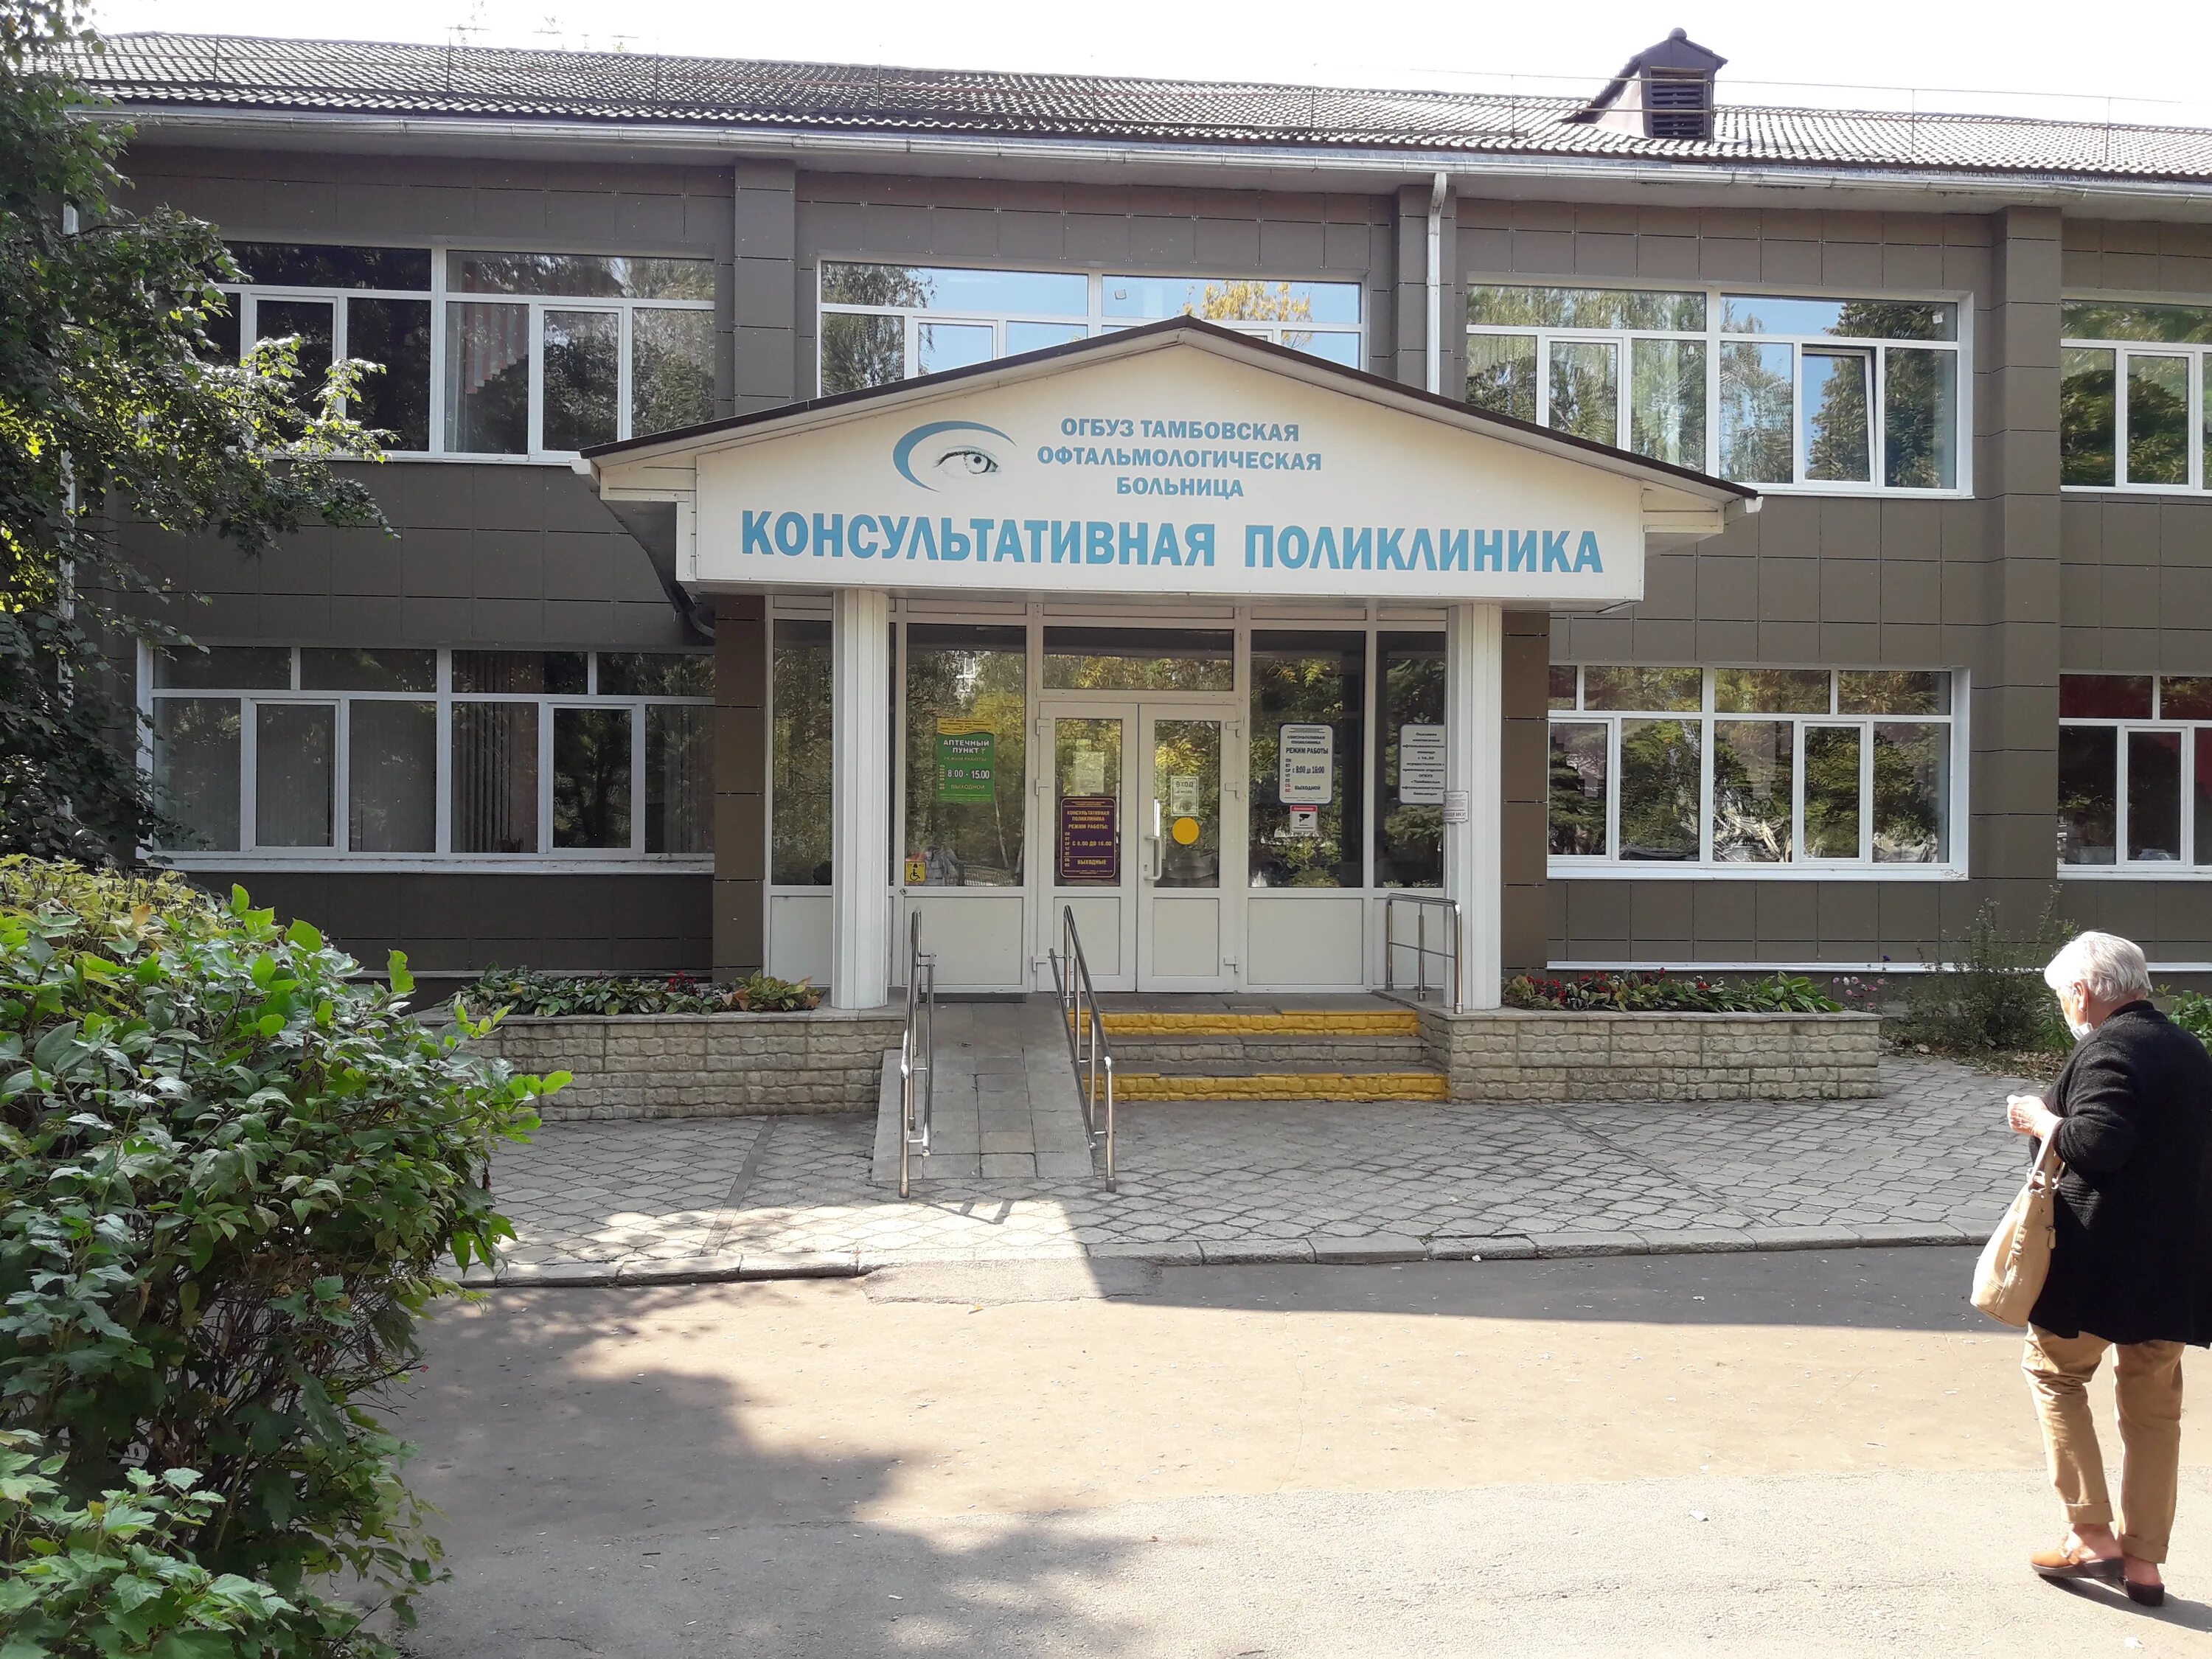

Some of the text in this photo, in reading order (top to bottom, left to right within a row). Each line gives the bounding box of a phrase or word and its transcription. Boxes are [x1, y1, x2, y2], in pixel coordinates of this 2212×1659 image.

[1061, 419, 1298, 440] ОГБУЗ ТАМБОВСКАЯ
[1037, 448, 1321, 470] ОФТАЛЬМОЛОГИЧЕСКАЯ
[1116, 476, 1243, 499] БОЛЬНИЦА
[742, 511, 1604, 574] КОНСУЛЬТАТИВНАЯ ПОЛИКЛИНИКА
[947, 769, 963, 777] 8.00
[970, 770, 990, 779] 15.00
